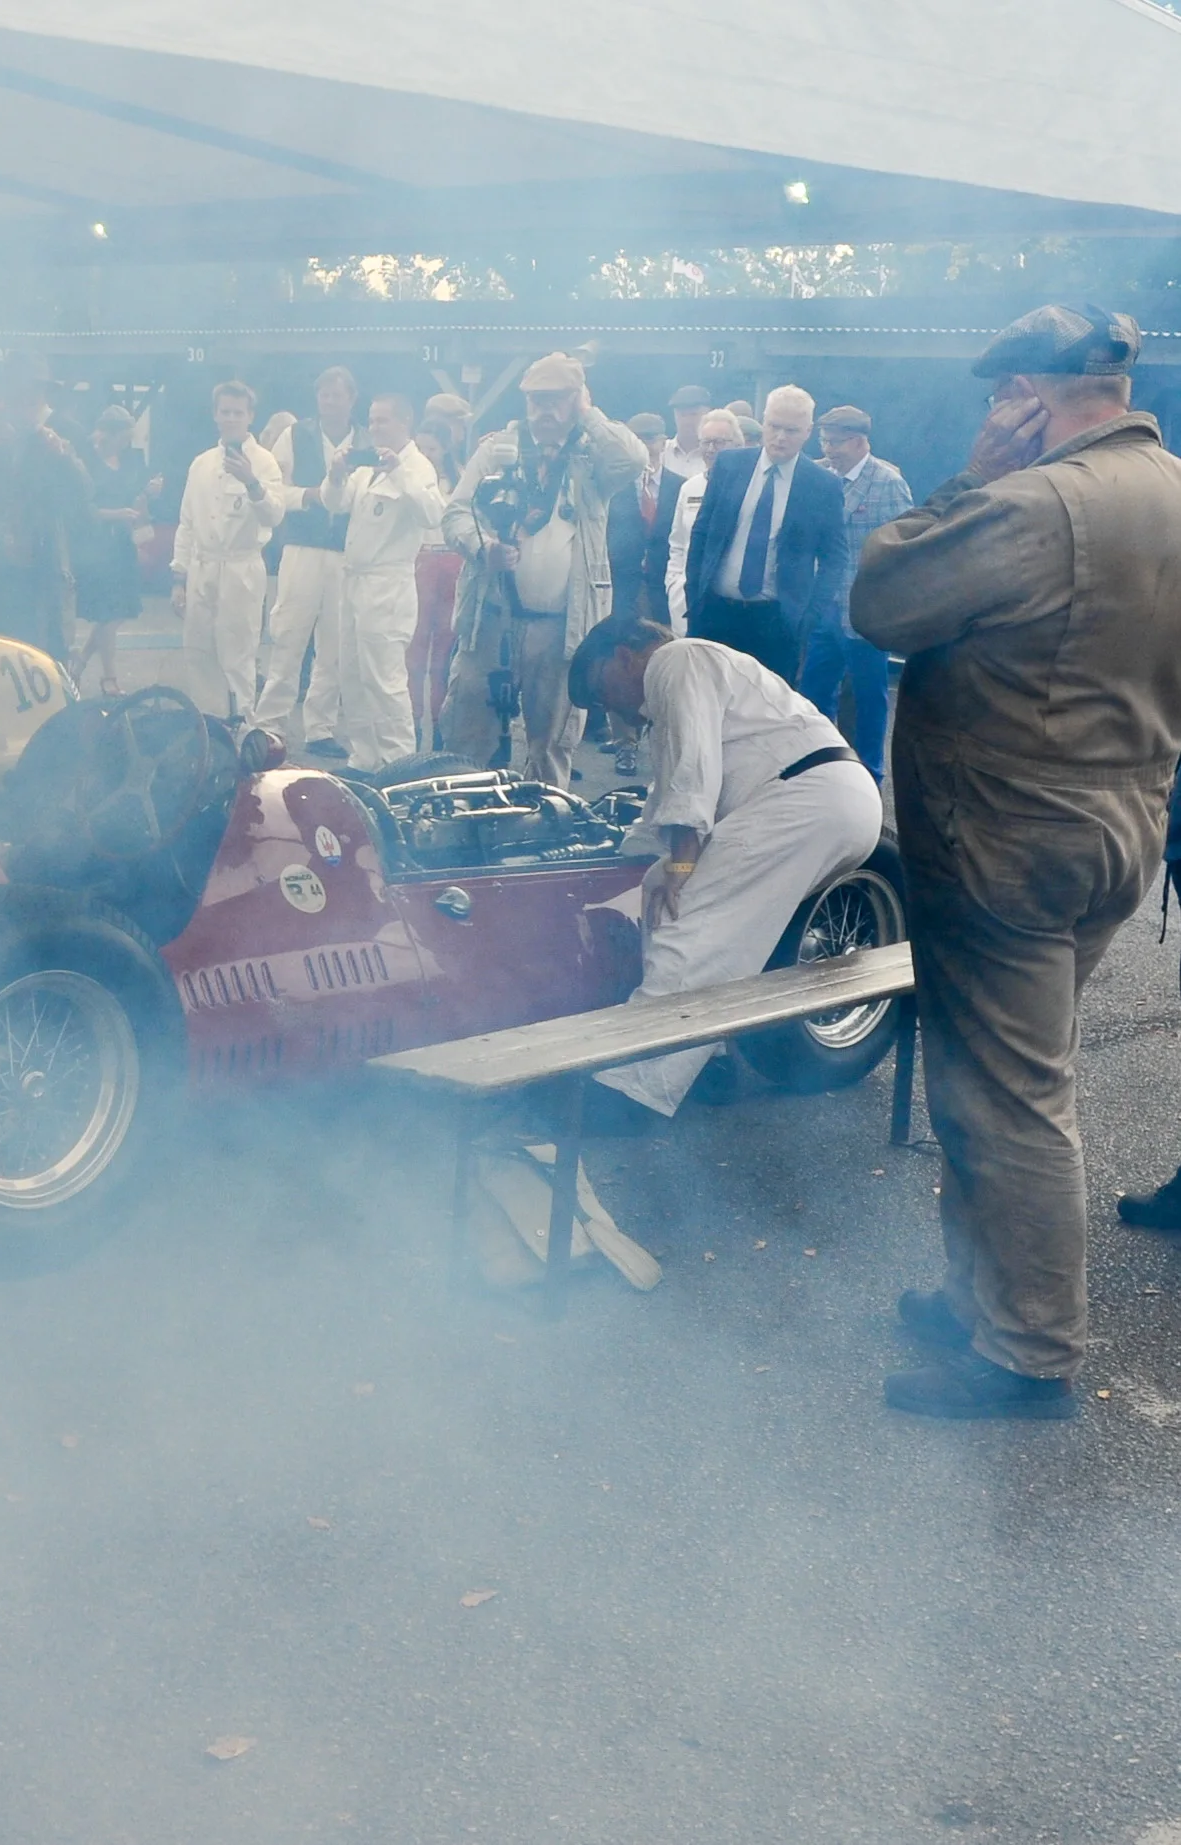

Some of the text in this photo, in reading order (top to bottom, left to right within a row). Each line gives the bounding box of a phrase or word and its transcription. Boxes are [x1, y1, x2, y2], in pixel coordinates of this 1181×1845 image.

[186, 346, 205, 362] 30
[422, 345, 439, 363] 31
[709, 350, 725, 368] 32
